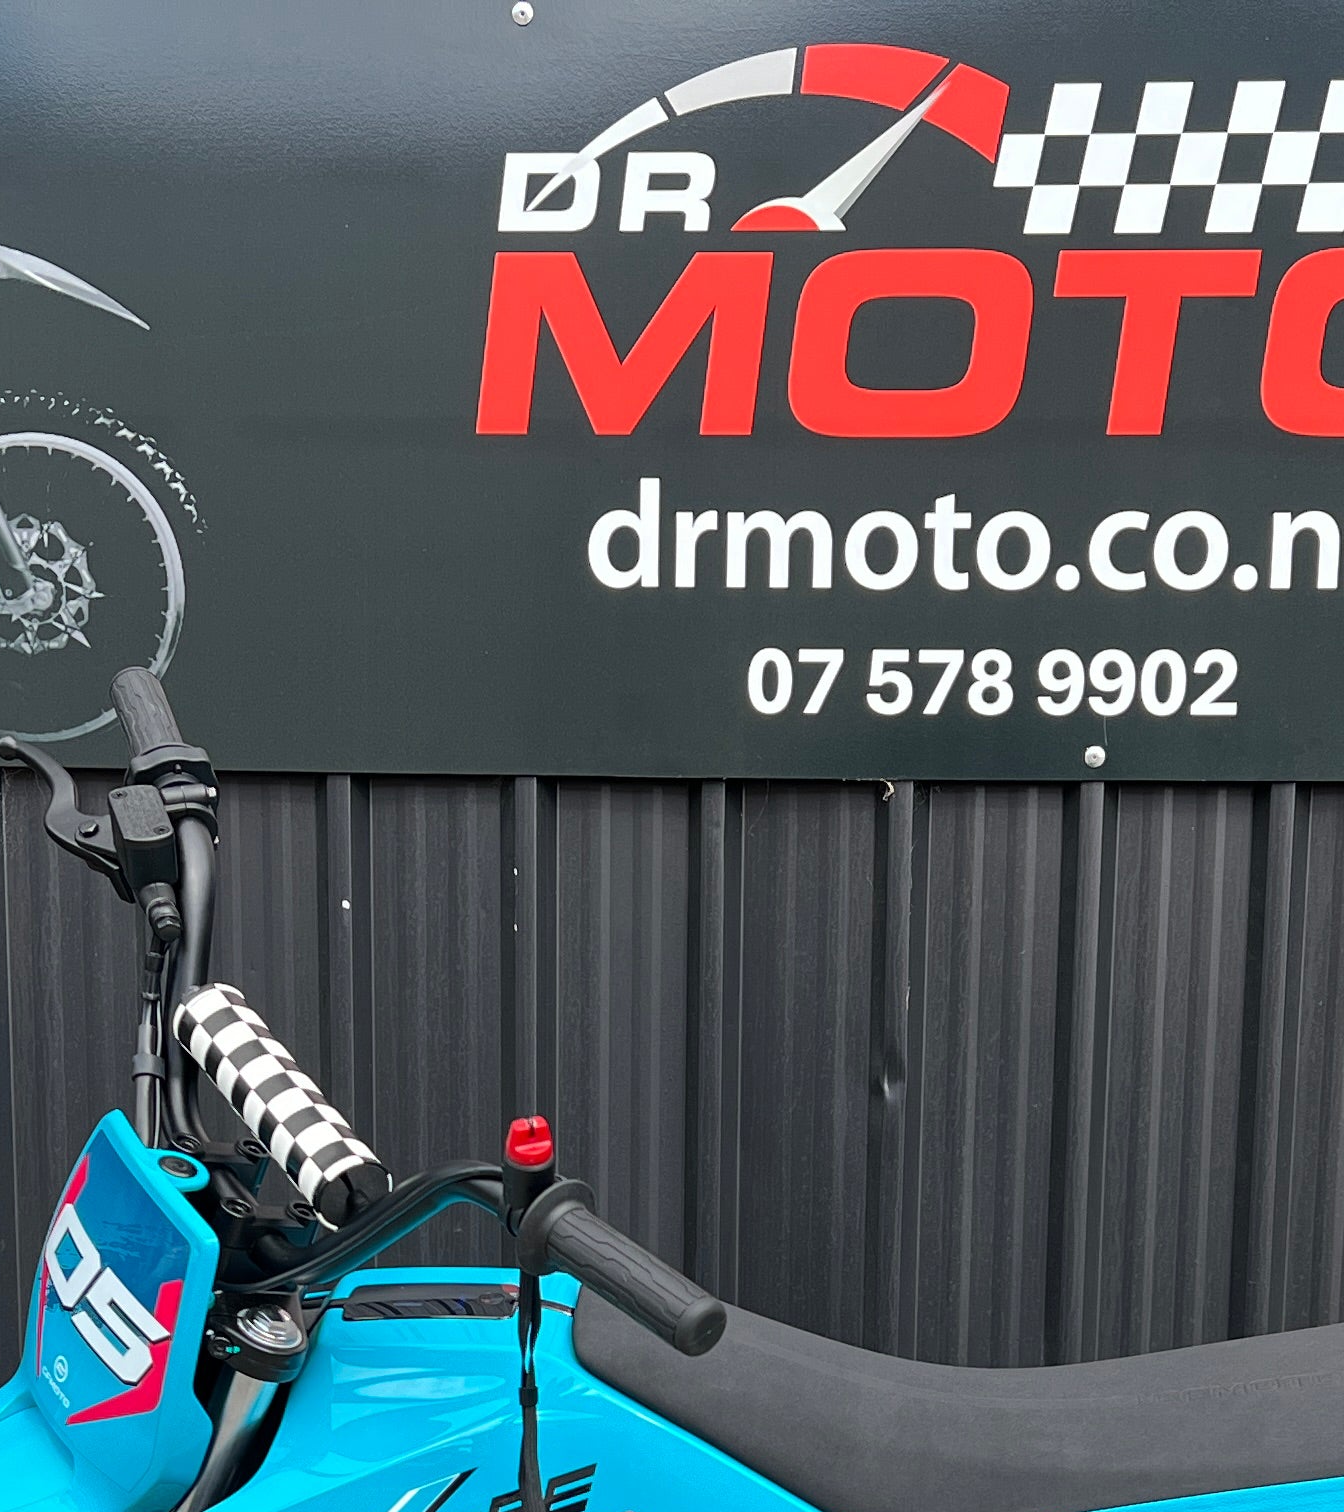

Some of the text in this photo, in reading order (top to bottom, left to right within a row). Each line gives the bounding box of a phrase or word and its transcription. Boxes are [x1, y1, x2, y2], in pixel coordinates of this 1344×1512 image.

[497, 151, 717, 233] DR
[746, 646, 1240, 719] 07 578 9902
[43, 1201, 172, 1386] 05
[41, 1365, 71, 1409] CFMOTO
